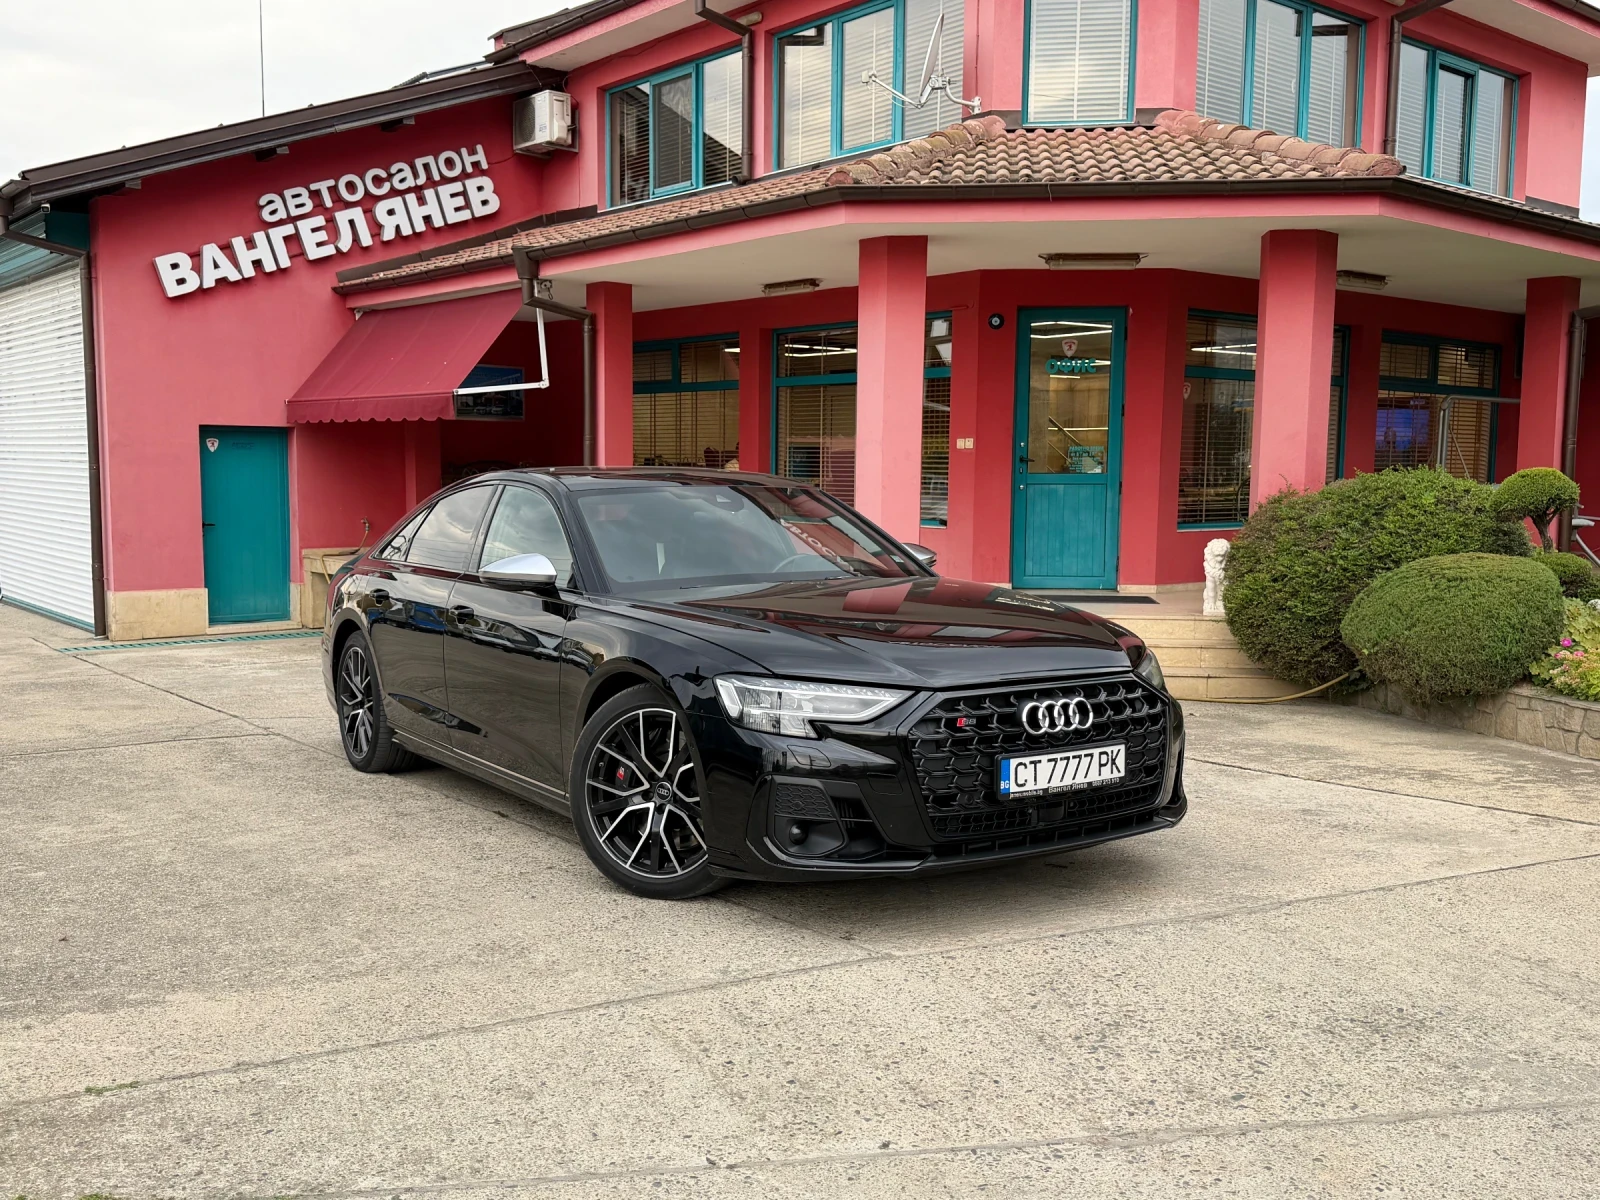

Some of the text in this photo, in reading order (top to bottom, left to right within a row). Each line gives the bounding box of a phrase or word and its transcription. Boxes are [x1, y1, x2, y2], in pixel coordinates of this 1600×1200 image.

[258, 144, 488, 223] автосалон
[153, 175, 500, 298] ВАНГЕЛ ЯНЕВ
[1045, 358, 1096, 374] ОФИС
